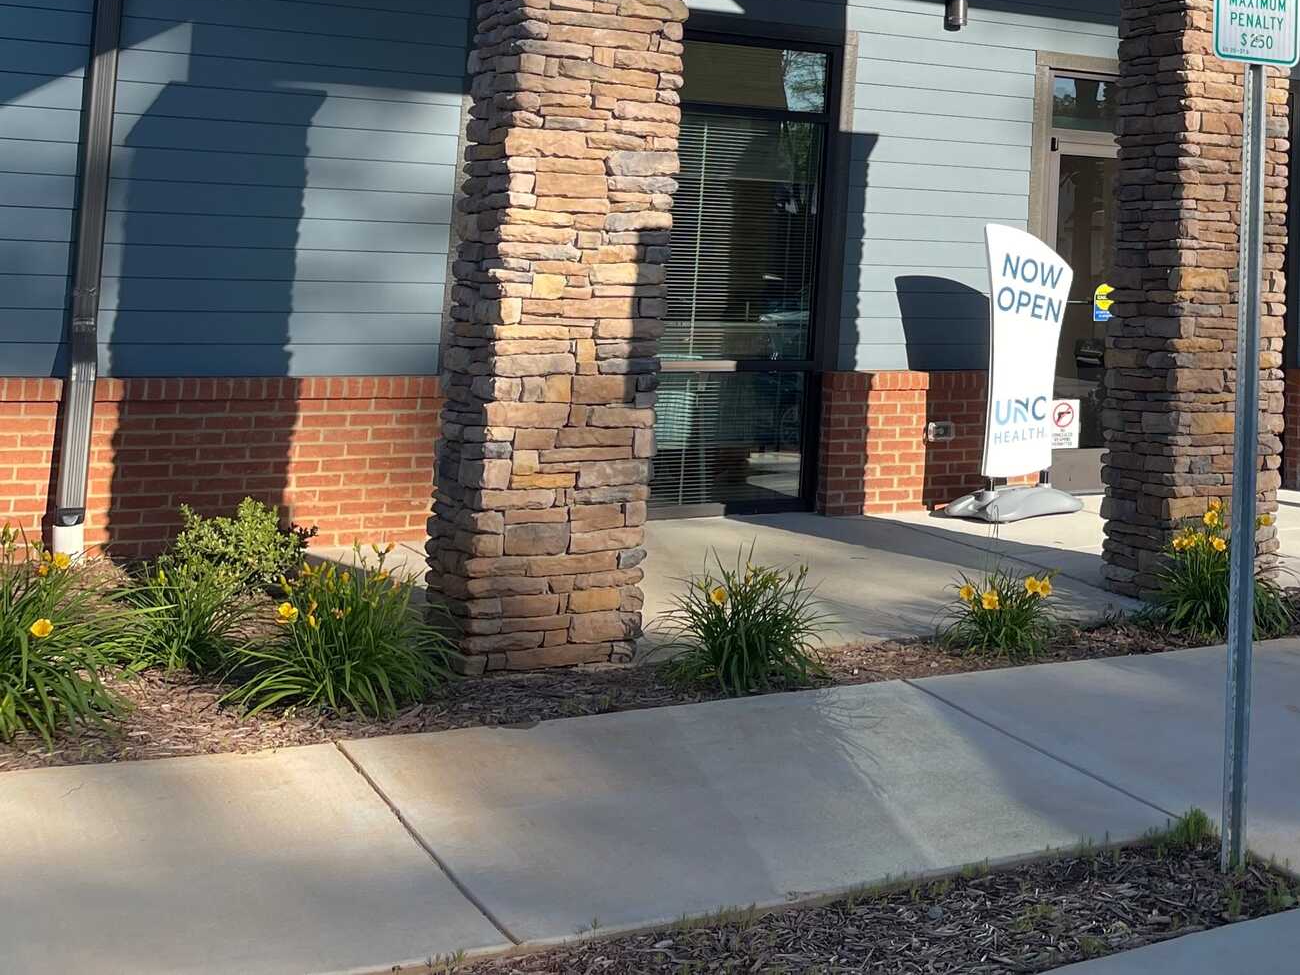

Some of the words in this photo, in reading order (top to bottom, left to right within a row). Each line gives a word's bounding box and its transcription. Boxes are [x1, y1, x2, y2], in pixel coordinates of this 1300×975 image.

[1230, 12, 1284, 31] PENALTY
[1002, 252, 1063, 289] NOW
[997, 286, 1062, 323] OPEN
[995, 395, 1047, 426] UNC
[994, 426, 1045, 445] HEALTH
